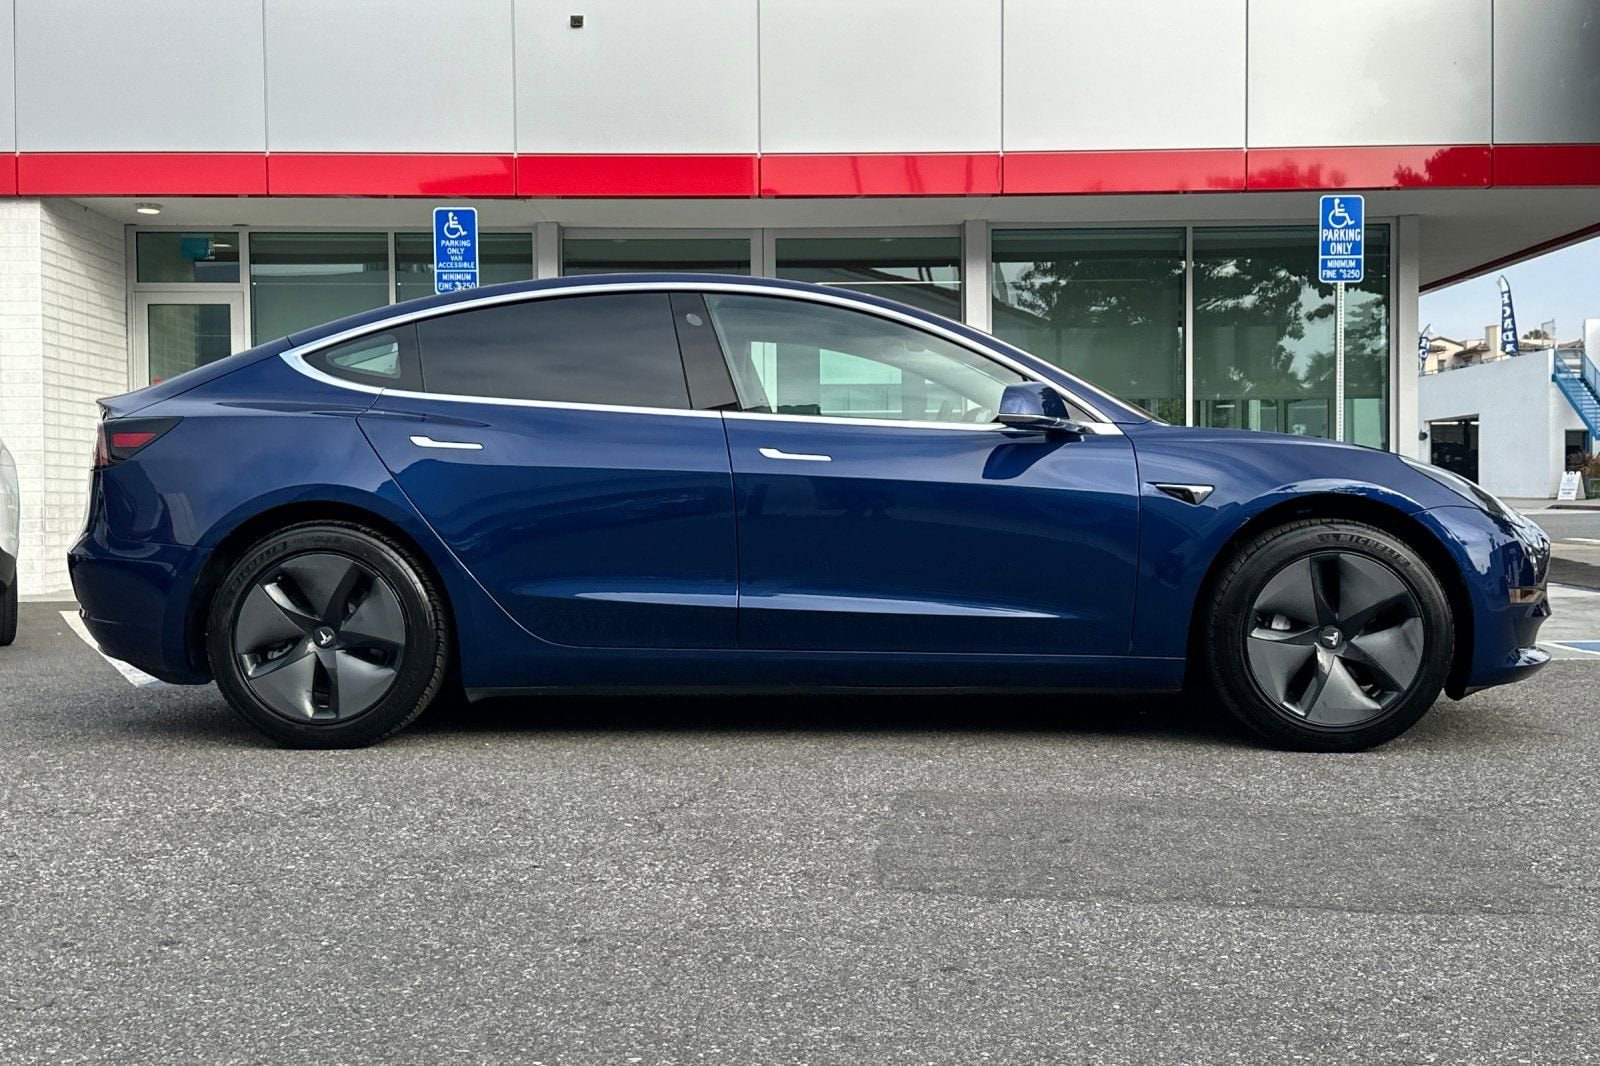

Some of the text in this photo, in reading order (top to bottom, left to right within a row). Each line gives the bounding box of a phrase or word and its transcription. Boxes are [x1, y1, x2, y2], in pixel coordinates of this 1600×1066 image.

[1322, 229, 1361, 241] PARKING
[1330, 242, 1353, 255] ONLY
[1327, 260, 1356, 268] MINIMUM
[1322, 269, 1337, 278] FINE
[1338, 534, 1409, 565] MICHELIN
